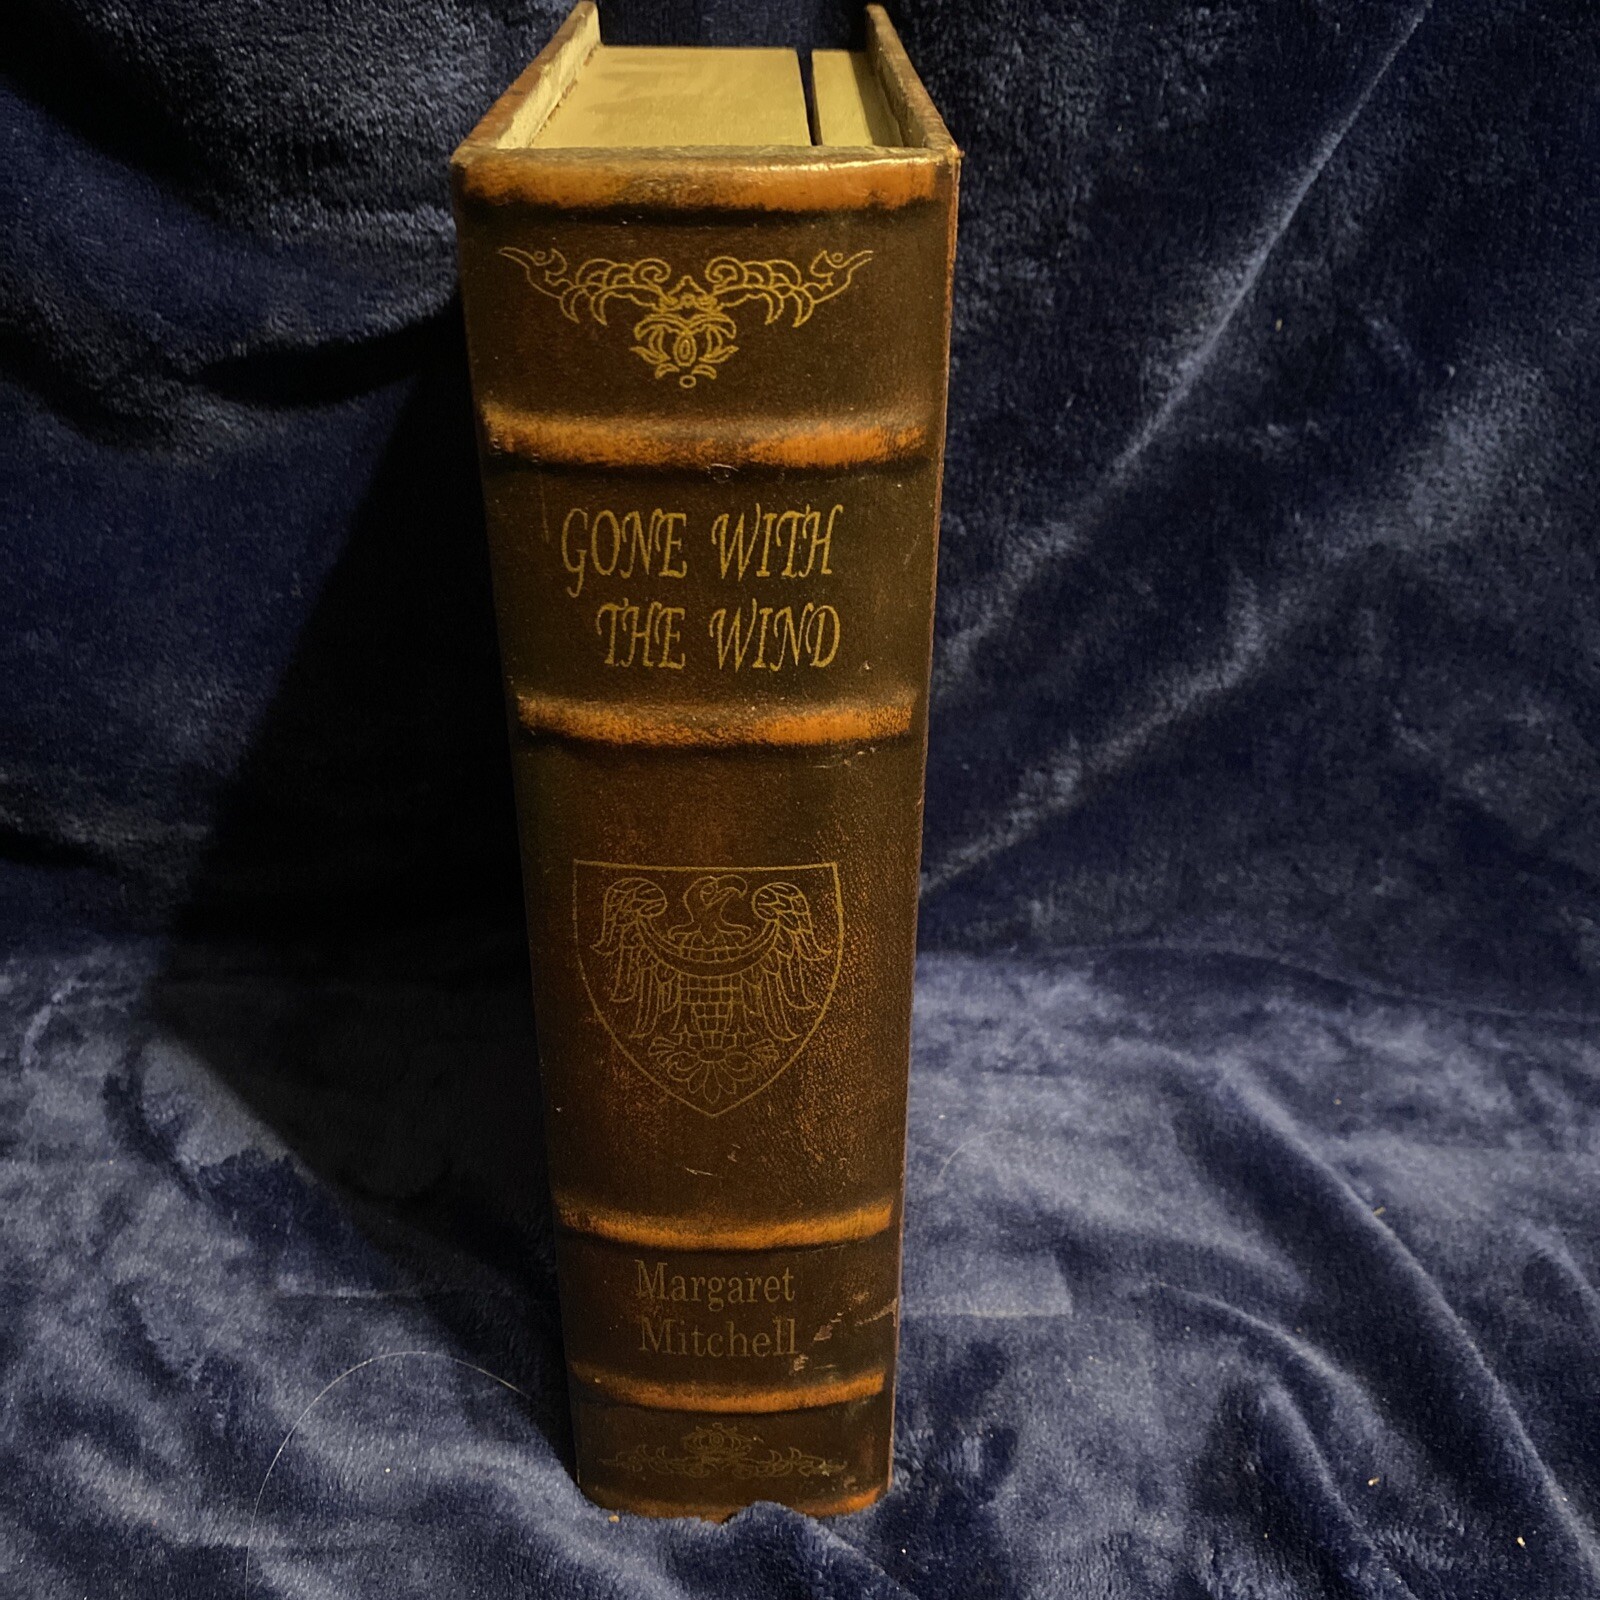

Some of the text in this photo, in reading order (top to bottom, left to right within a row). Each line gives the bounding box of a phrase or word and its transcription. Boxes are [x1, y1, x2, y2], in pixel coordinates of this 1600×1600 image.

[561, 503, 844, 598] GONE WITH
[596, 597, 841, 673] THE WIND
[634, 1259, 796, 1312] Margaret
[638, 1315, 799, 1358] Mitchell
